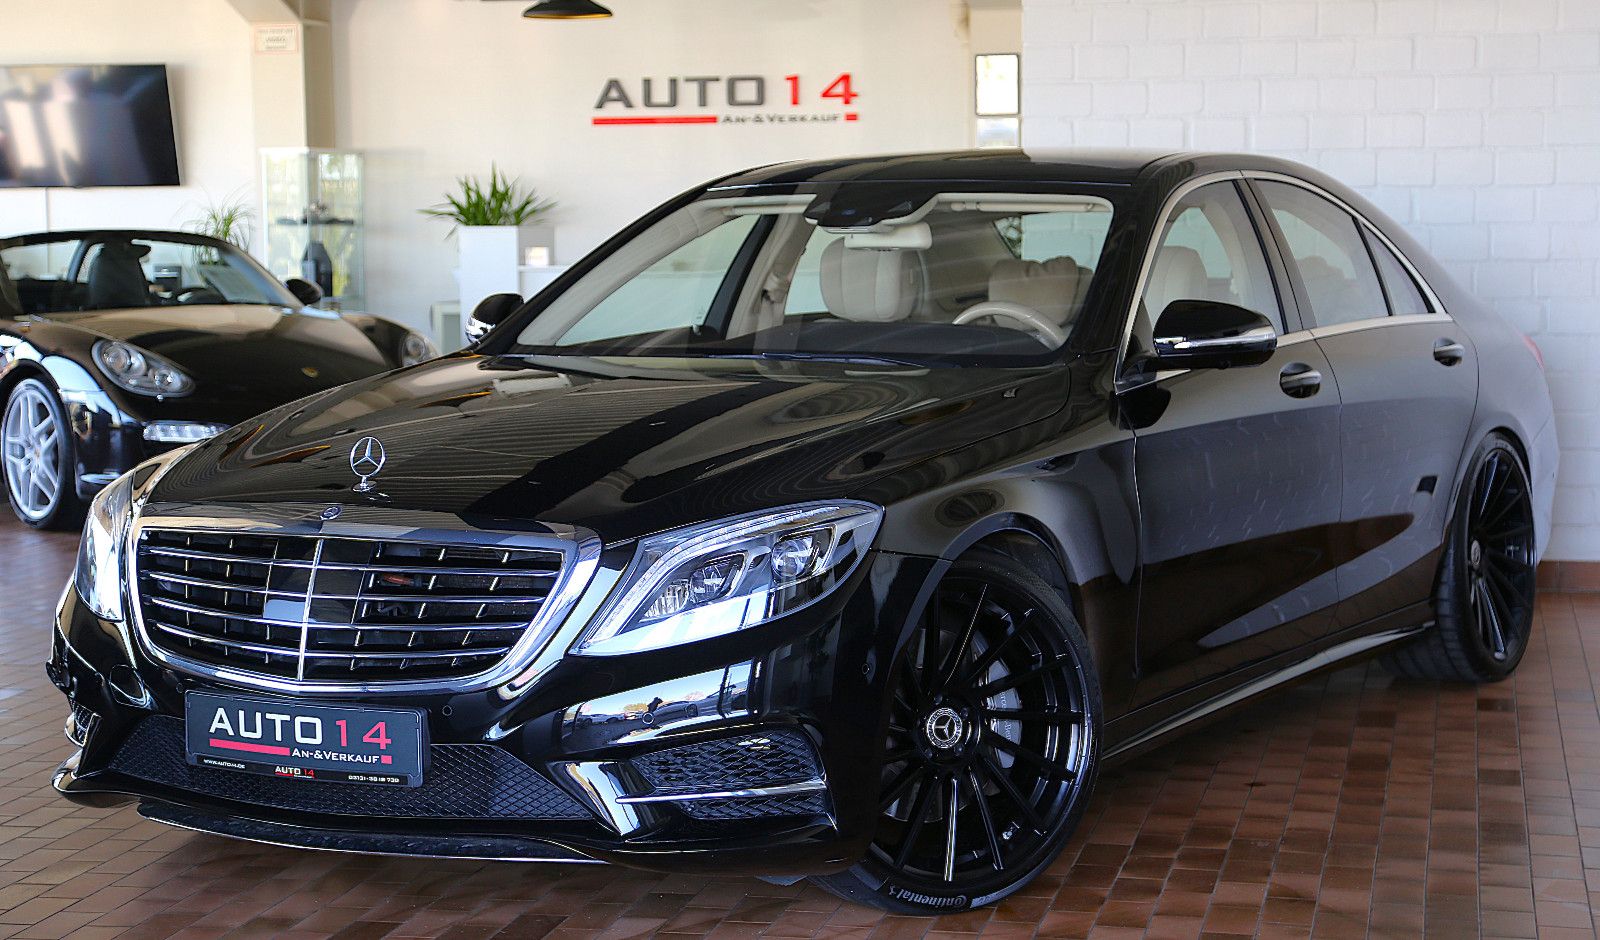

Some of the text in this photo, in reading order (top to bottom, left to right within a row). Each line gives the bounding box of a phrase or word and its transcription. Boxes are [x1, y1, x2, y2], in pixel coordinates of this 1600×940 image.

[594, 73, 859, 109] AUTO 14
[208, 707, 393, 750] AUTO 14
[274, 765, 301, 775] AUTO
[303, 768, 316, 779] 14
[896, 888, 968, 908] Continental
